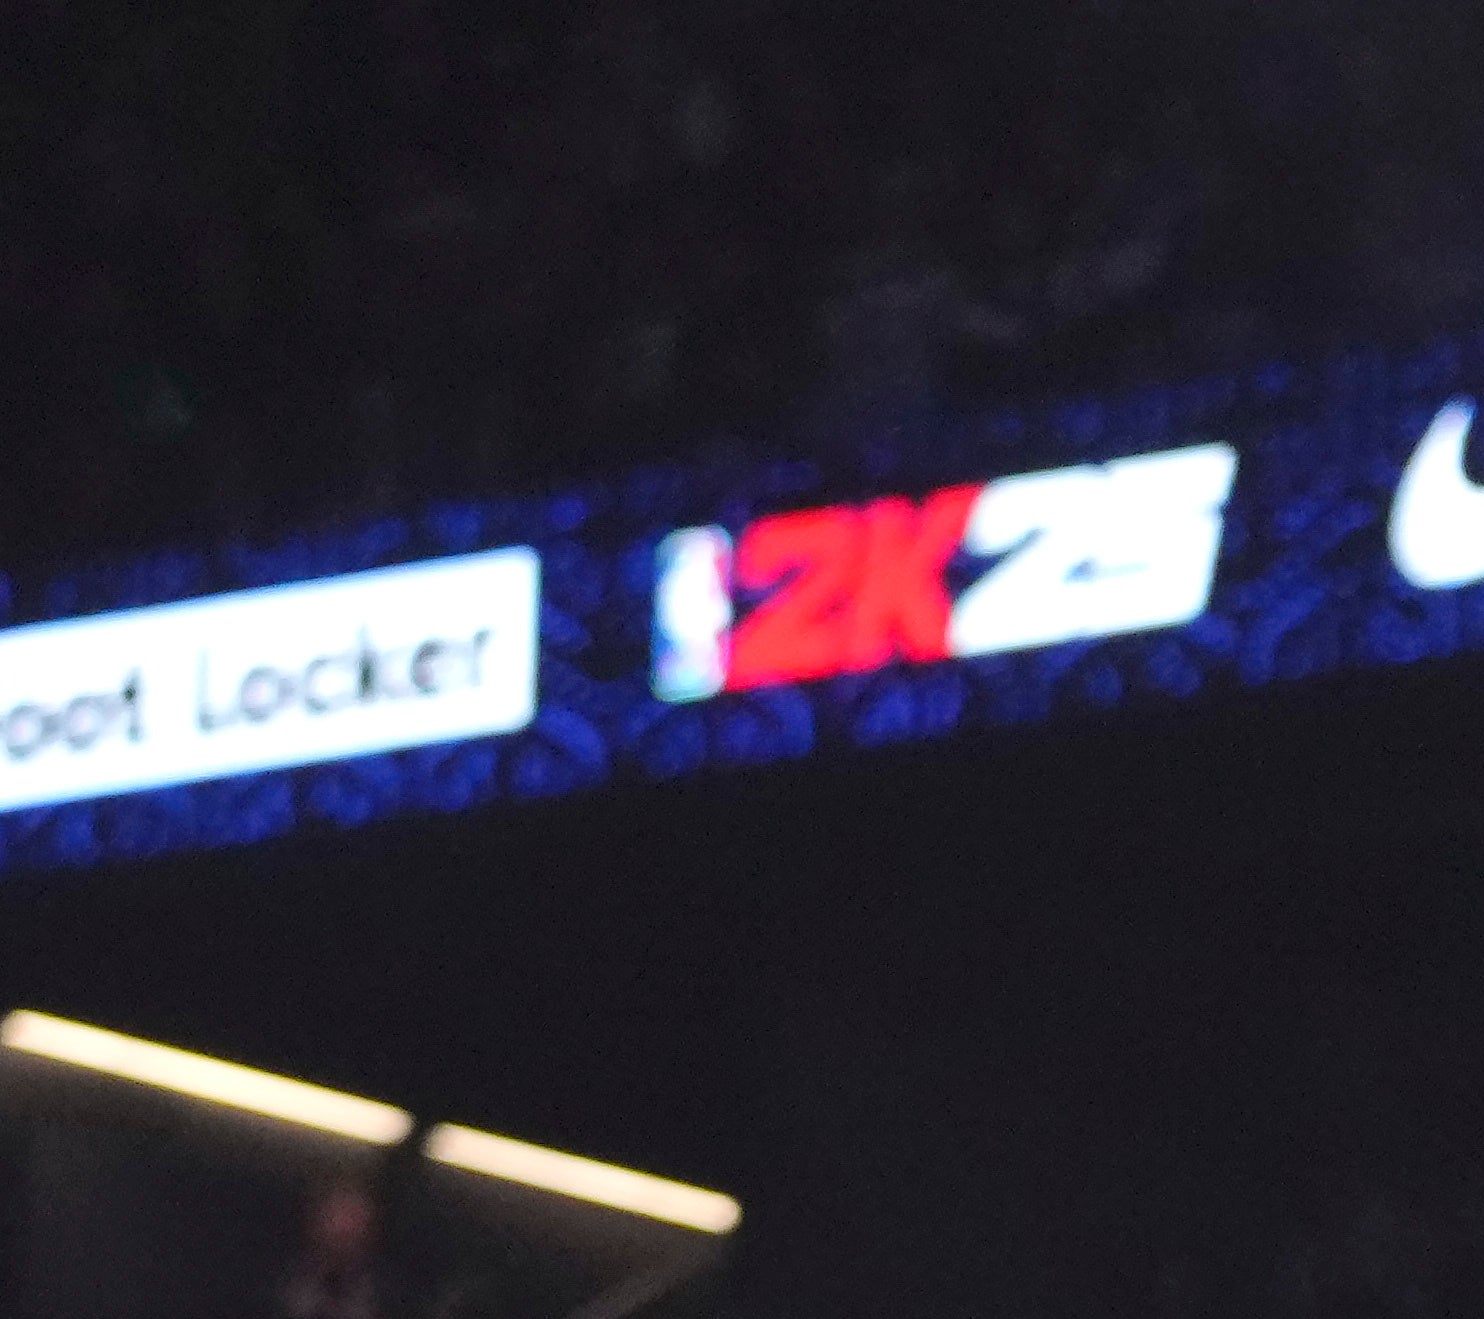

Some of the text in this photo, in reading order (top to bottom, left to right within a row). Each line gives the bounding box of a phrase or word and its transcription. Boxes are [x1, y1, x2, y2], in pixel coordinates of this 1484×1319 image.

[724, 444, 1236, 692] 2K25
[0, 624, 494, 763] oot Locker
